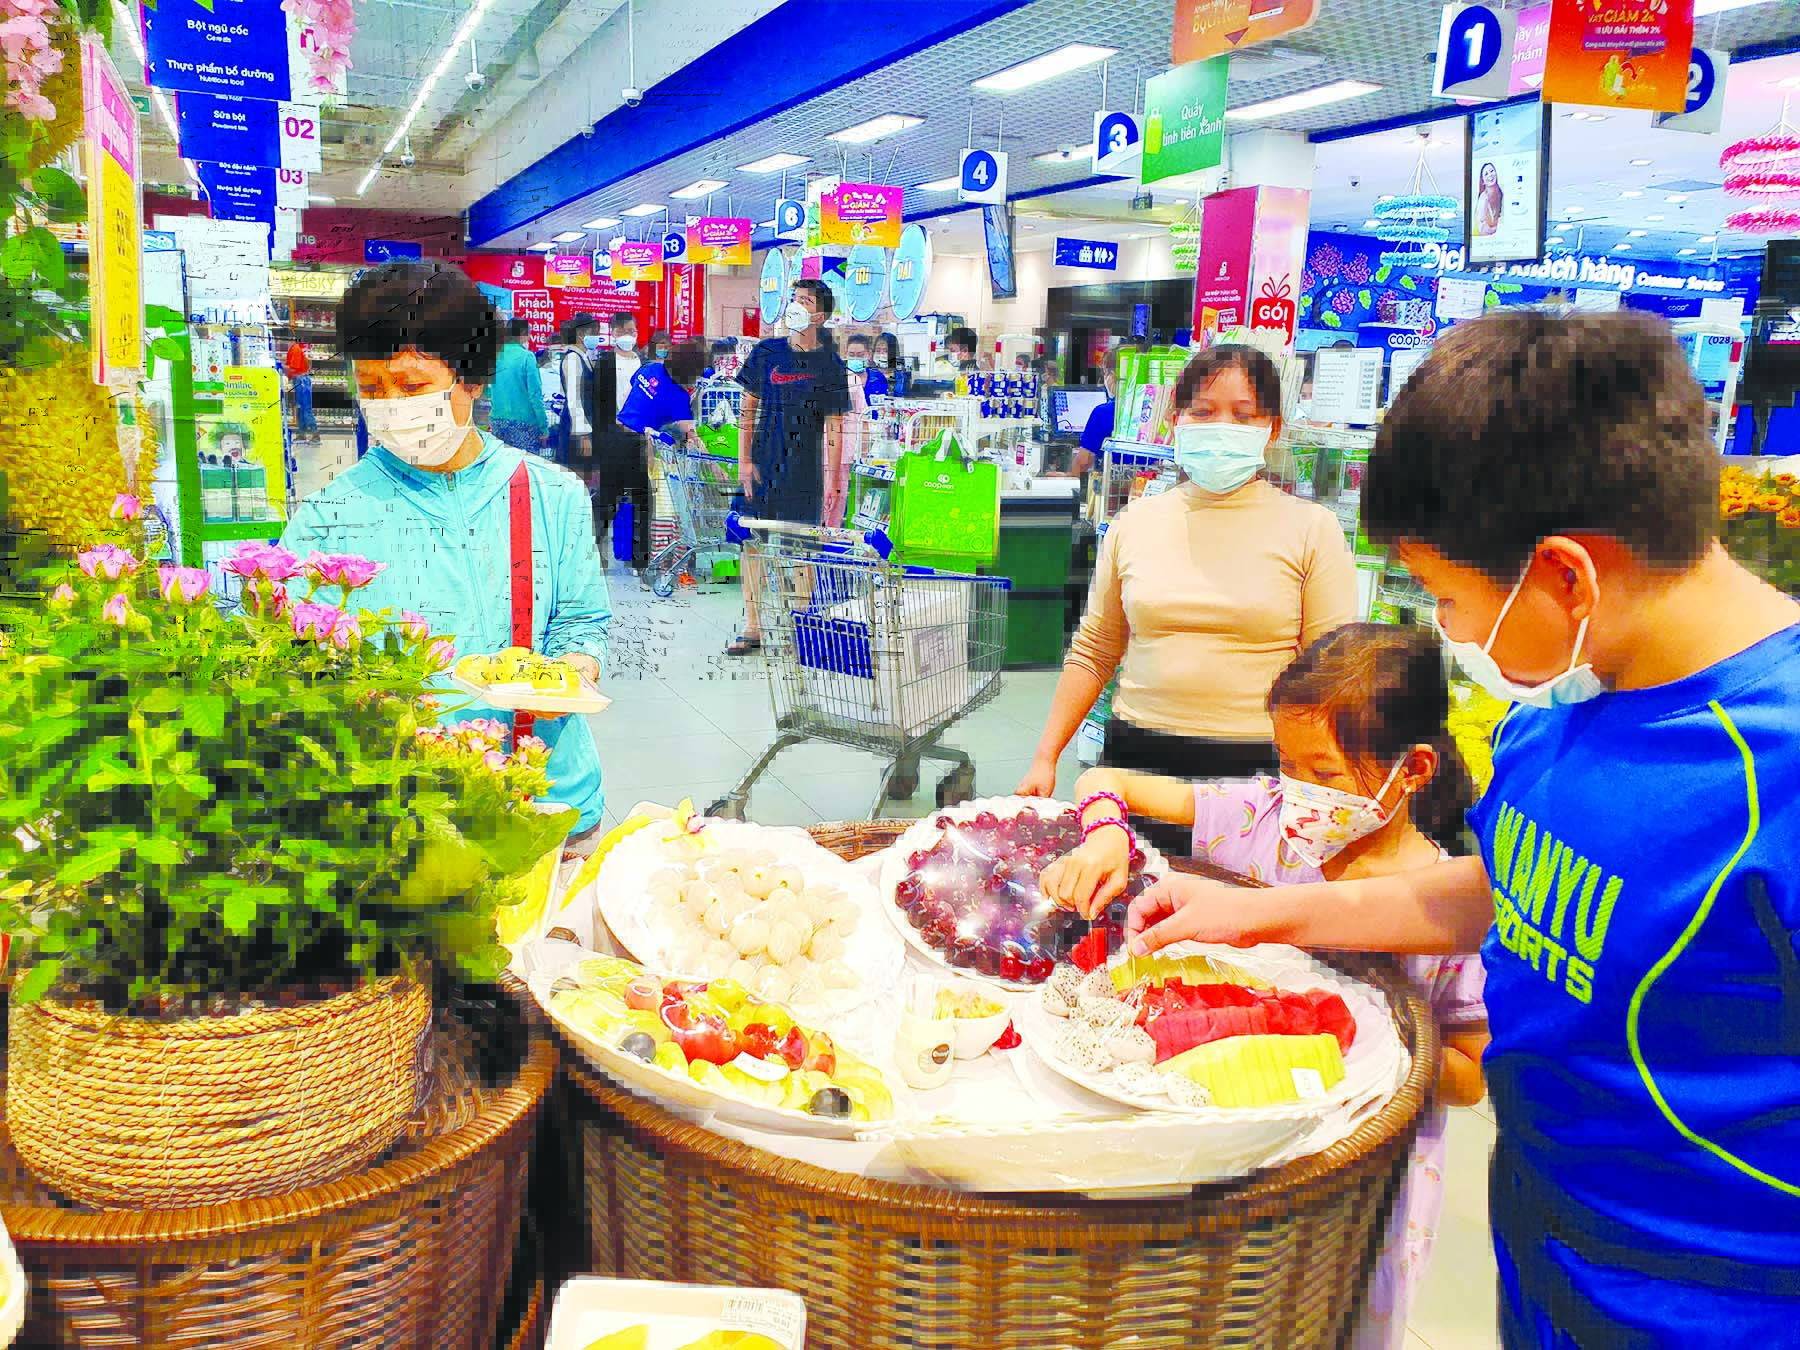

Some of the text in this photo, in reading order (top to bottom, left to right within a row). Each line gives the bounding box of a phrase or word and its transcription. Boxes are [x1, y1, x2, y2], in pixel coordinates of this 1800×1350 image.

[186, 19, 249, 36] Bột ngũ cốc
[1464, 22, 1485, 66] 1
[166, 58, 194, 72] Thực
[195, 62, 224, 76] phẩm
[240, 68, 275, 82] dưỡng
[1687, 63, 1703, 101] 2
[285, 116, 315, 139] 02
[1108, 123, 1129, 153] 3
[279, 168, 303, 185] 03
[972, 160, 989, 185] 4
[784, 206, 799, 227] 6
[281, 274, 336, 289] WHISKY
[1580, 255, 1635, 291] hàng
[519, 297, 554, 309] khách
[1258, 301, 1288, 321] GÓI
[525, 309, 555, 322] hàng
[1494, 801, 1623, 962] WANYU
